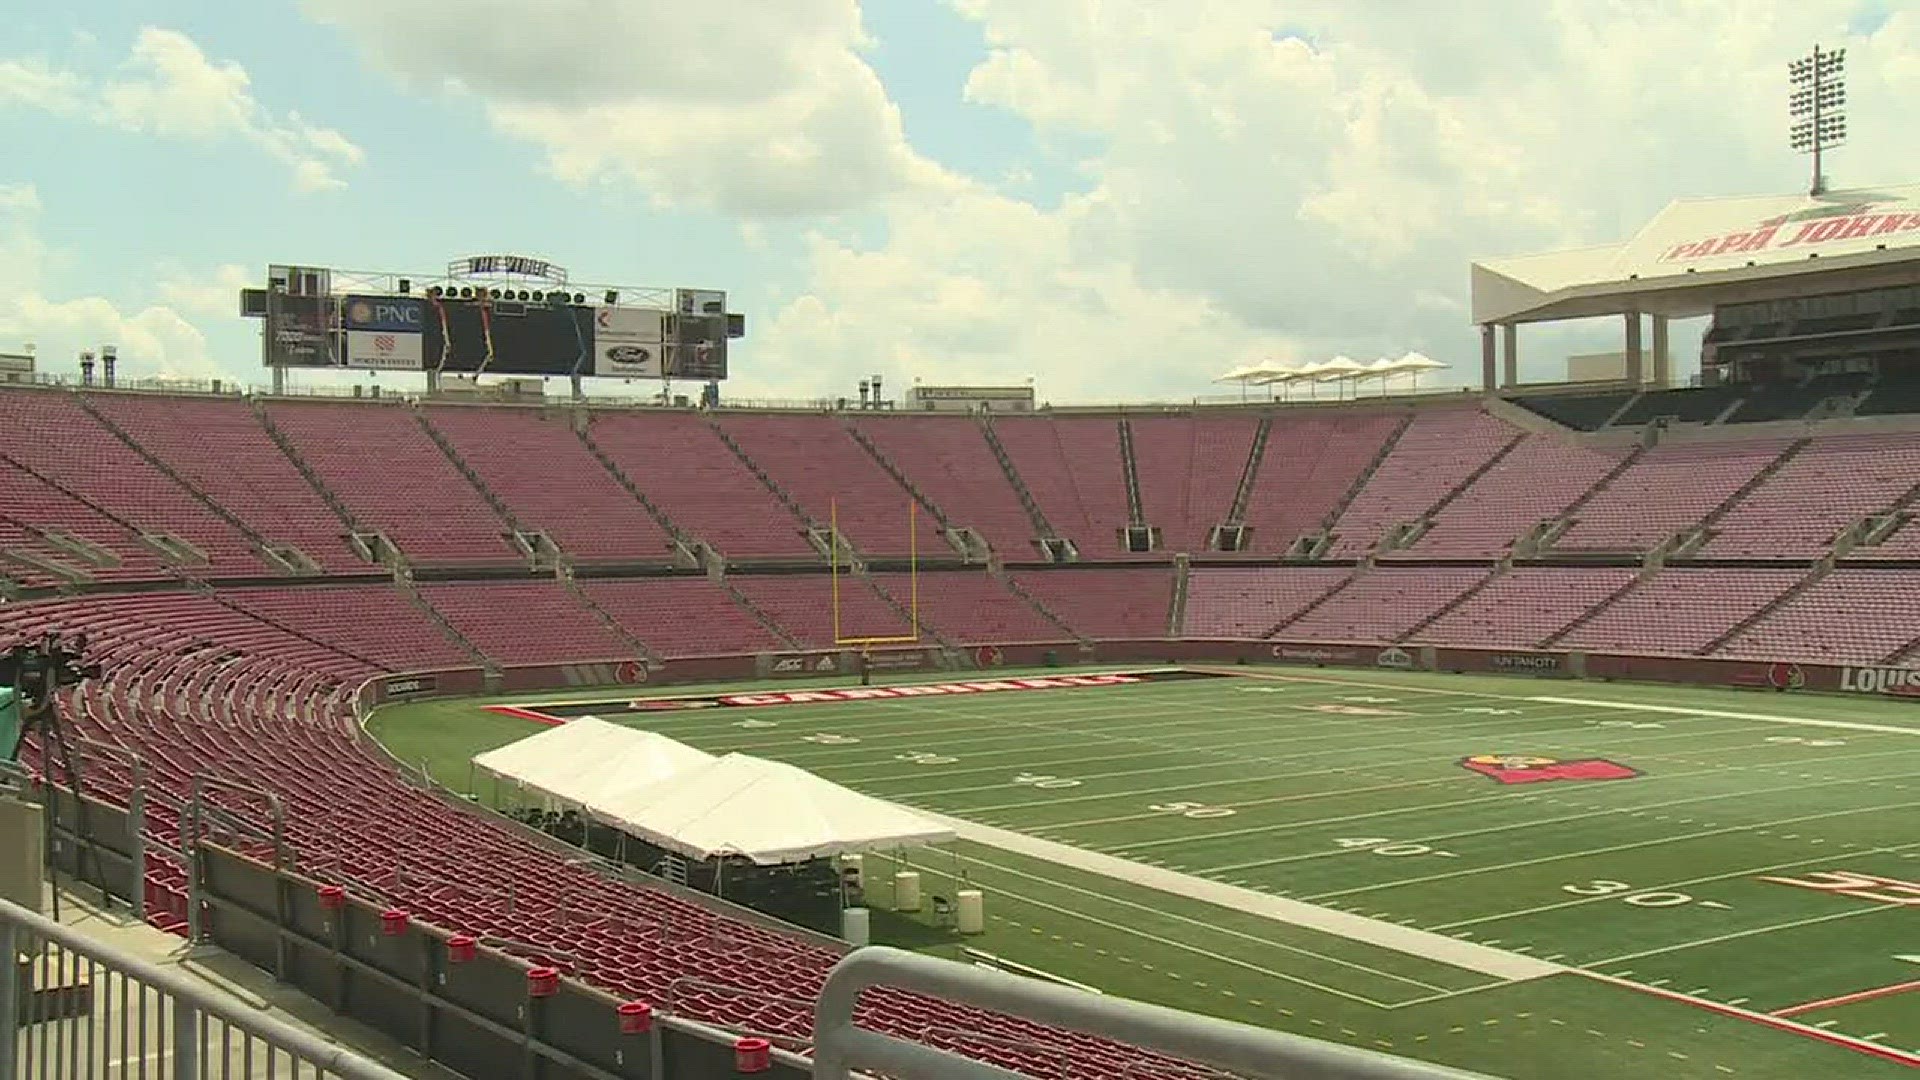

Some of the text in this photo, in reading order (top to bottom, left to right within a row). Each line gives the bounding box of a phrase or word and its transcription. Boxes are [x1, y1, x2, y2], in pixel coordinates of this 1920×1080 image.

[1664, 226, 1780, 258] PAPA
[375, 304, 420, 323] PNC
[1148, 802, 1237, 818] 50
[1332, 837, 1432, 855] 40
[1561, 880, 1694, 906] 30
